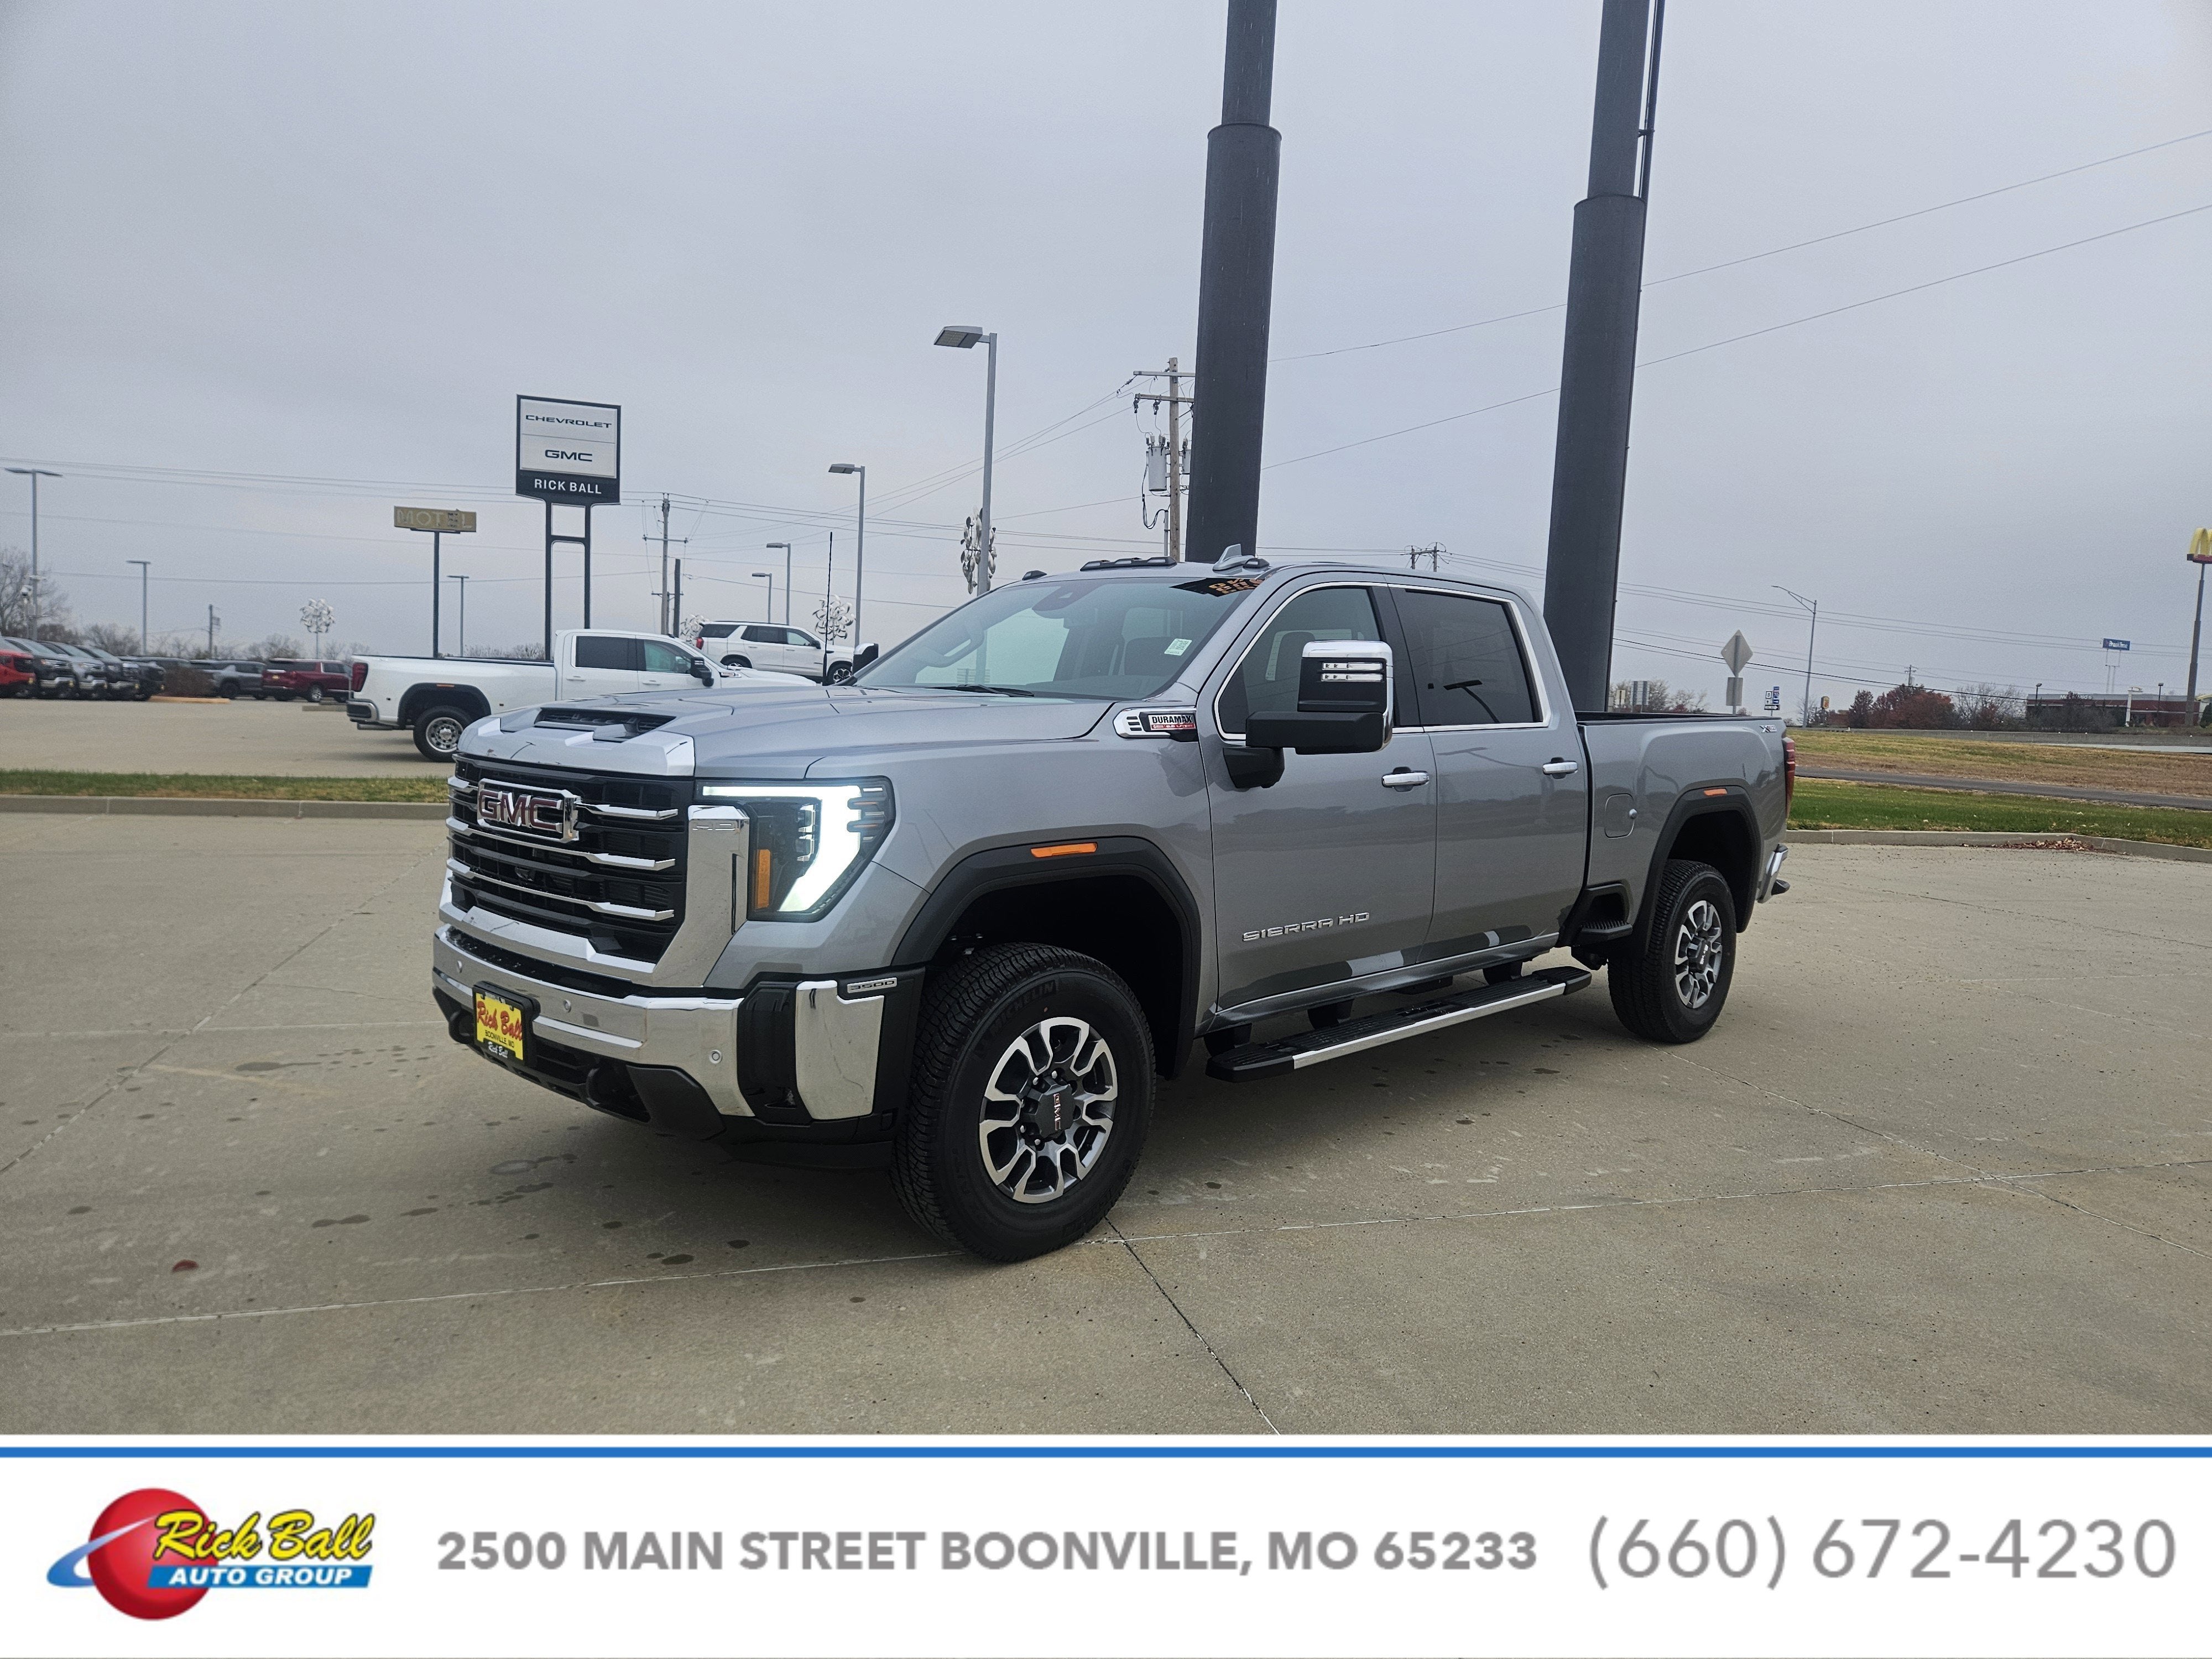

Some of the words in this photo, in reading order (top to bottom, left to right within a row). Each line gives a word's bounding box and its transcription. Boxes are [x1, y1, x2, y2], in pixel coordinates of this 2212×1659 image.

[525, 415, 612, 429] CHEVROLET
[545, 449, 593, 462] GMC
[534, 478, 566, 491] RICK
[570, 482, 602, 494] BALL
[397, 509, 473, 529] MOTEL
[1152, 716, 1193, 724] DURAMAX
[478, 789, 563, 833] GMC
[1243, 918, 1333, 941] SIERRA
[1338, 912, 1370, 925] HD
[850, 980, 894, 990] 3500
[477, 1000, 498, 1031] Rick
[500, 1010, 523, 1041] Ball
[1053, 1093, 1061, 1131] GMC
